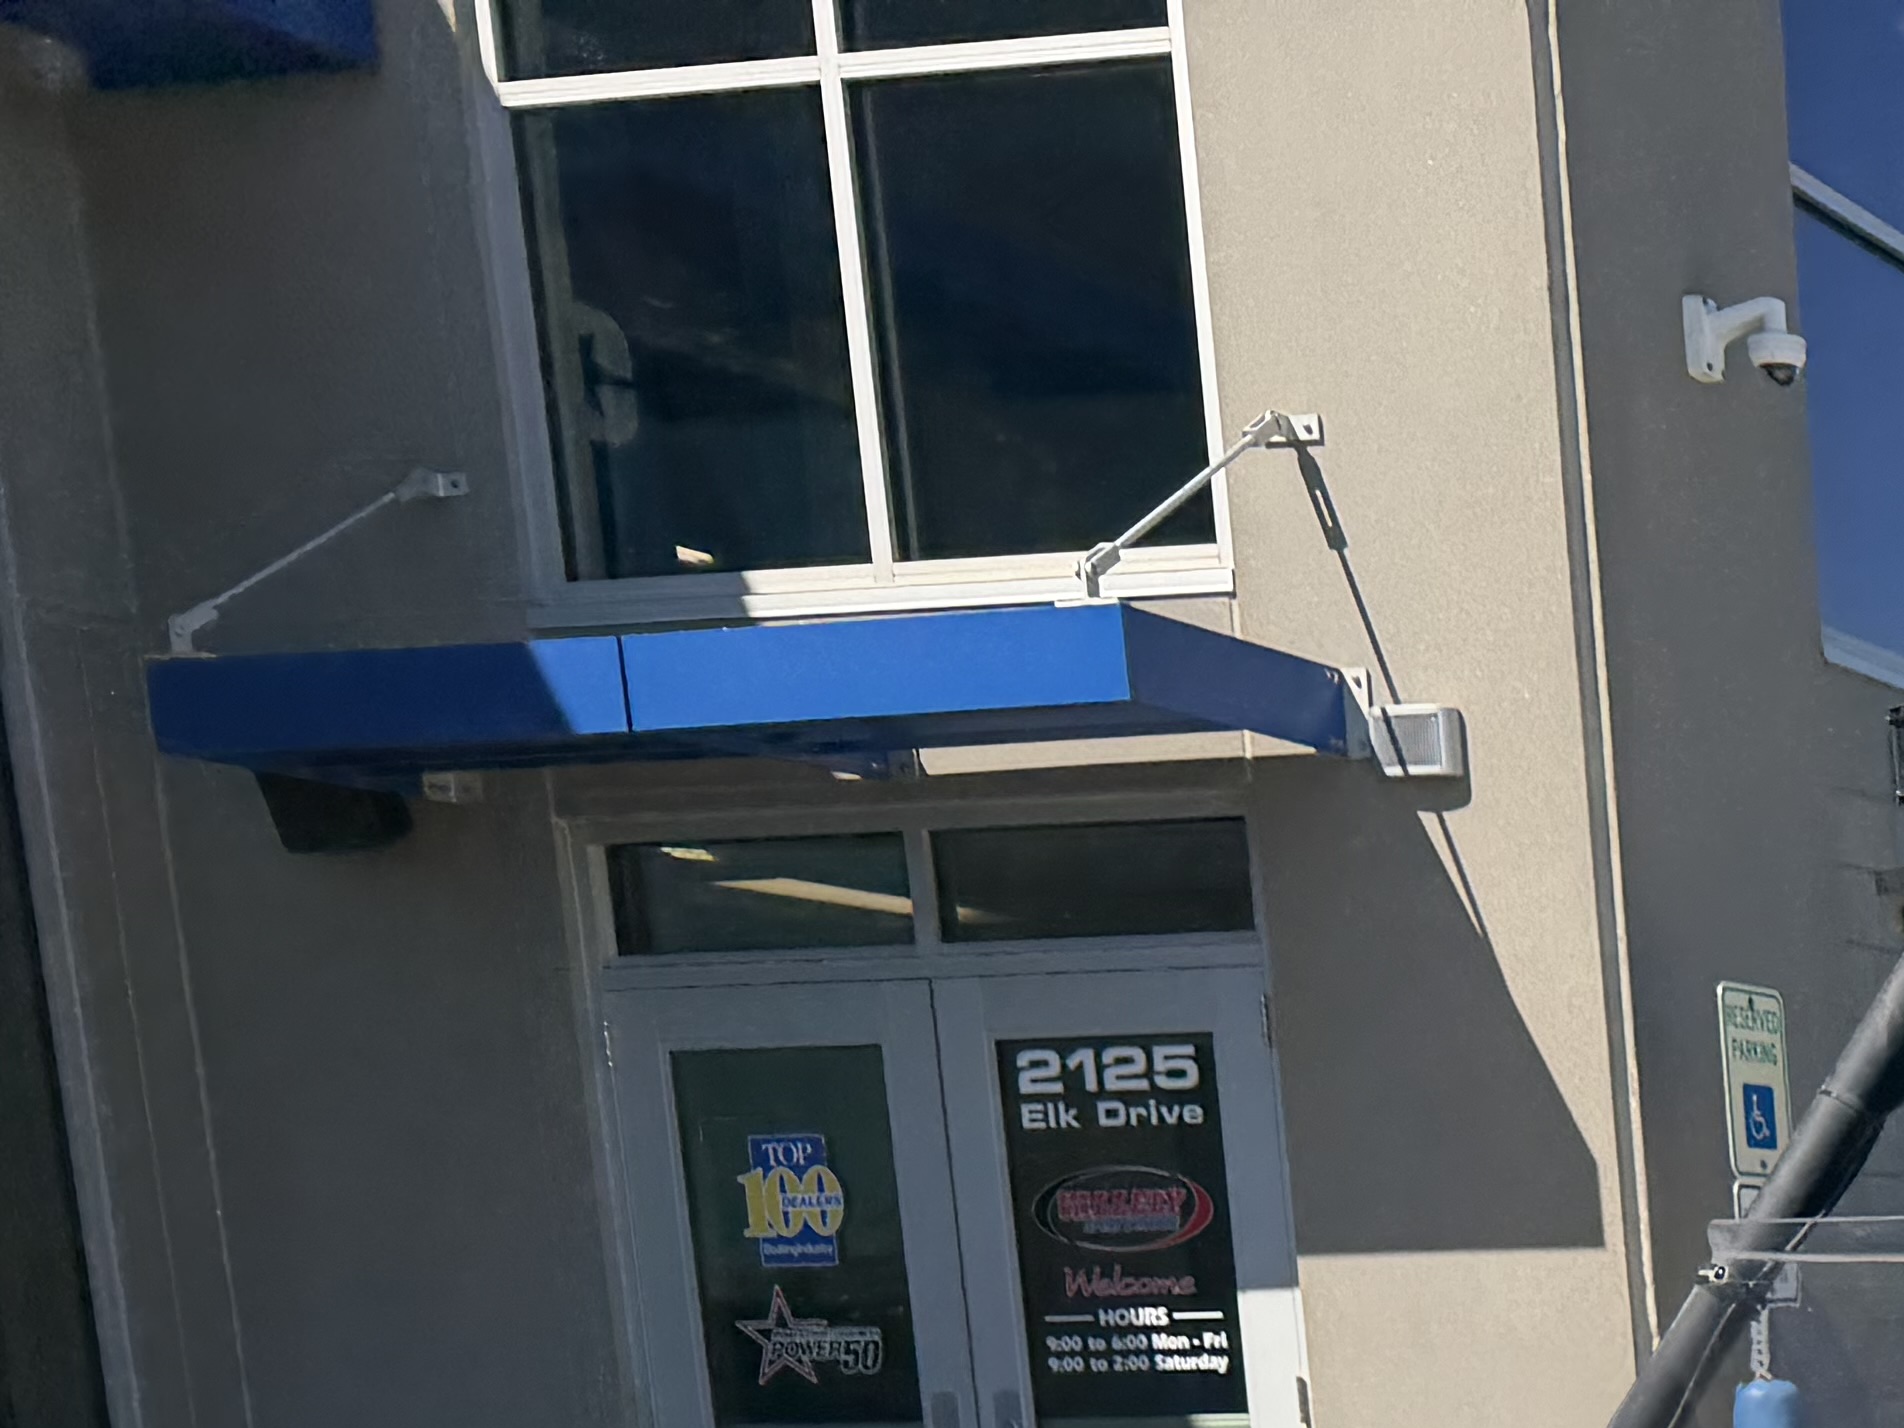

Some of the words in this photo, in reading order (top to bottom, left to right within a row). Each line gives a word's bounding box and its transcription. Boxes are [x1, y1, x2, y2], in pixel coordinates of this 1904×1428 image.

[1725, 1004, 1780, 1036] RESERVED
[1731, 1037, 1778, 1066] PARKING
[1016, 1043, 1200, 1095] 2125
[1020, 1100, 1082, 1130] Elk
[1097, 1098, 1204, 1128] Drive
[761, 1142, 813, 1167] TOP
[737, 1165, 844, 1238] 100
[1064, 1262, 1197, 1298] Welcome
[1098, 1306, 1170, 1327] HOURS
[1046, 1335, 1083, 1351] 9:00
[1088, 1336, 1107, 1351] to
[1151, 1332, 1190, 1350] Mon
[1202, 1331, 1230, 1349] Fri
[1047, 1355, 1085, 1373] 9:00
[1089, 1356, 1108, 1372] to
[1112, 1354, 1150, 1372] 2:00
[1154, 1352, 1230, 1375] Saturday
